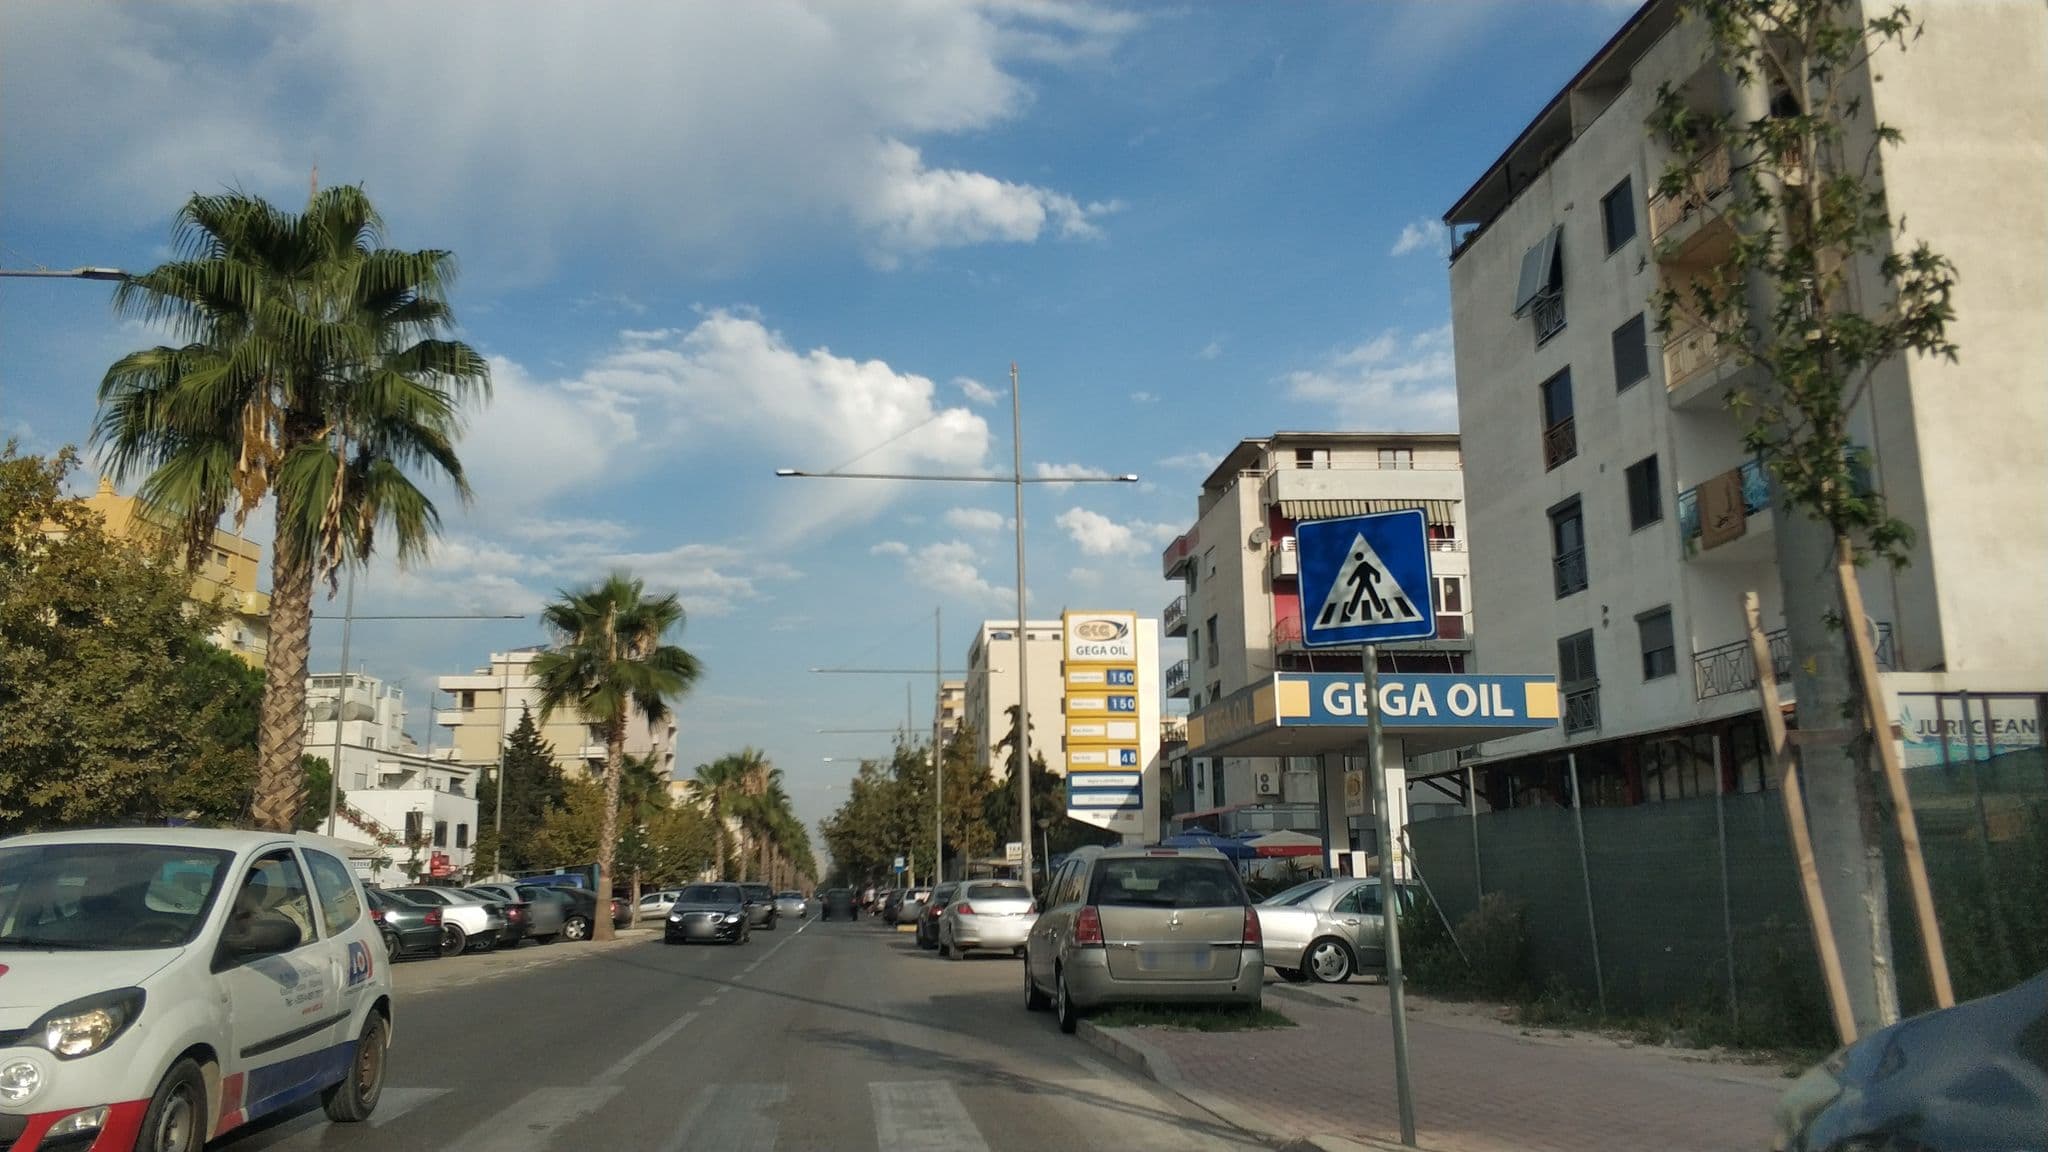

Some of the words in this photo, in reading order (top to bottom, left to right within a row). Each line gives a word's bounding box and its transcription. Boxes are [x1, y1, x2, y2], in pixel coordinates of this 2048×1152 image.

[1076, 646, 1107, 656] GEGA
[1110, 646, 1128, 656] OIL
[1112, 673, 1134, 683] 150
[1112, 699, 1135, 709] 150
[1323, 681, 1436, 717] GEGA
[1446, 682, 1515, 718] OIL
